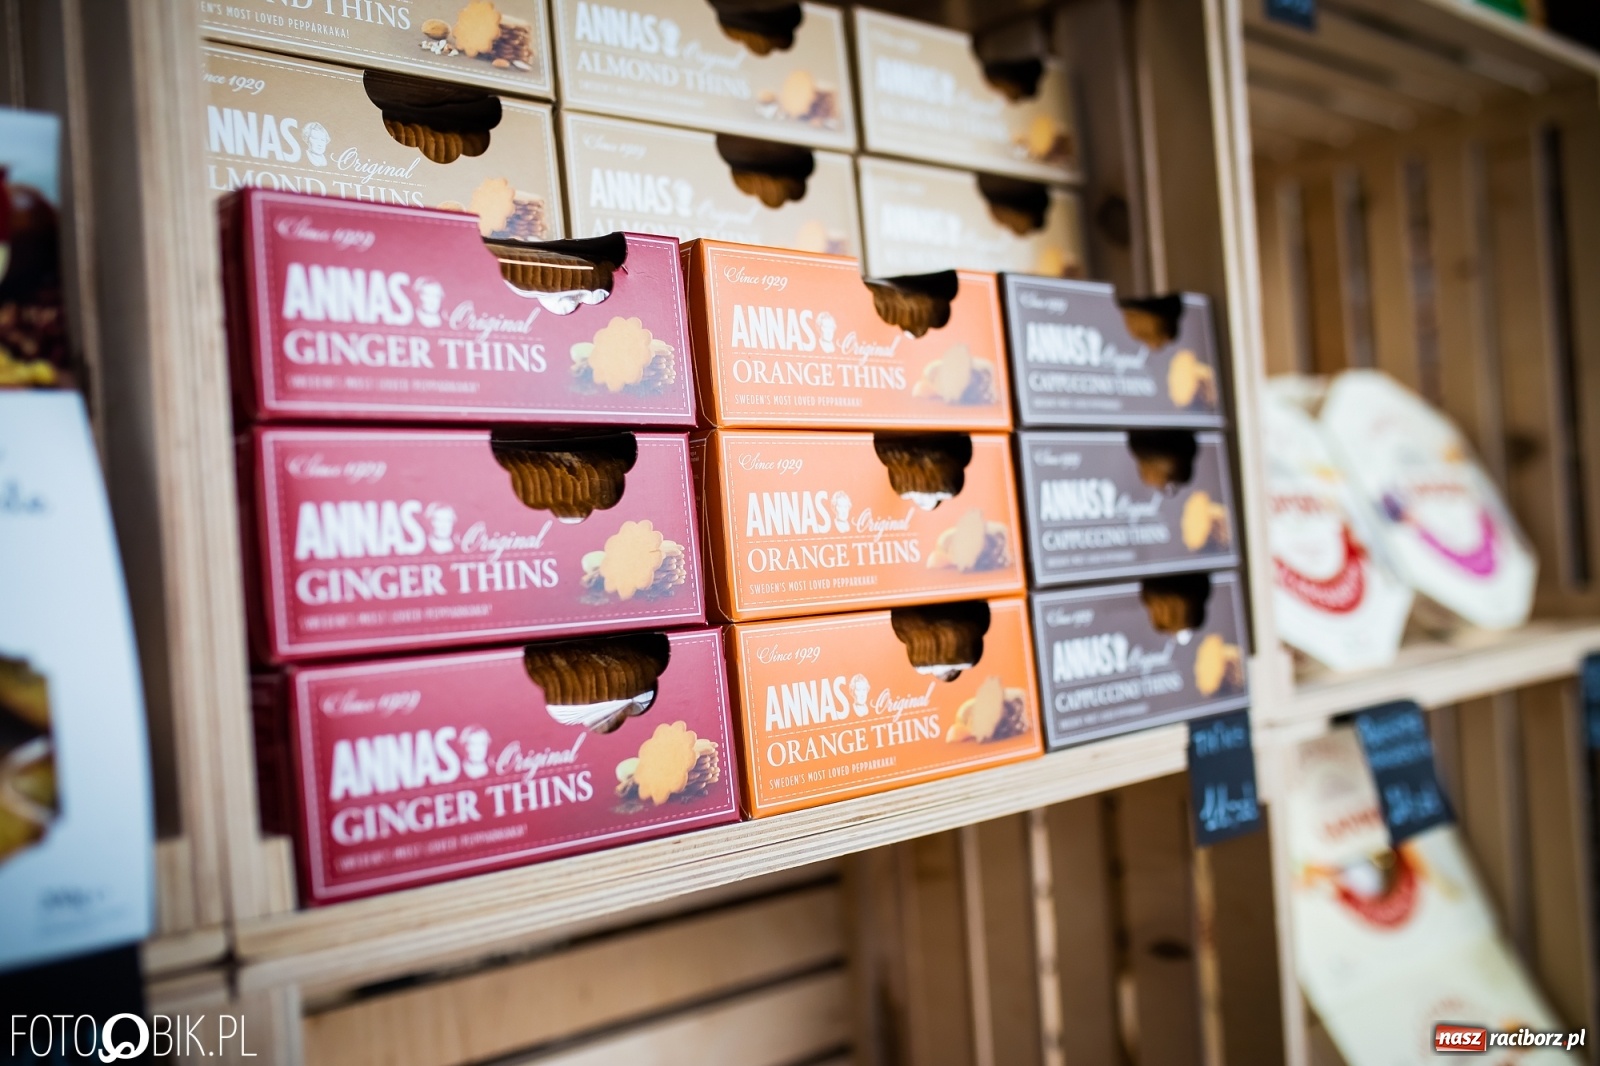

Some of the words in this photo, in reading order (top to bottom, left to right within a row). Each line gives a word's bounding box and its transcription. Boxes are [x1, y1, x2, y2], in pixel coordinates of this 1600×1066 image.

[200, 2, 223, 15] EN'S
[226, 6, 251, 20] MOST
[255, 12, 284, 26] LOVED
[288, 18, 350, 38] PEPPARKAKA!
[574, 1, 658, 55] ANNAS
[229, 75, 265, 95] 1929
[576, 50, 679, 87] ALMOND
[684, 69, 751, 99] THINS
[207, 105, 302, 164] NNAS
[207, 165, 326, 197] LMOND
[332, 181, 424, 208] THINS
[330, 146, 421, 185] Original
[590, 167, 673, 216] ANNAS
[282, 263, 414, 328] ANNAS
[724, 264, 759, 284] Since
[761, 274, 788, 292] 1929
[442, 300, 541, 344] Original
[731, 304, 816, 352] ANNAS
[283, 329, 436, 369] GINGER
[439, 338, 548, 374] THINS
[836, 331, 900, 366] Original
[732, 359, 834, 387] ORANGE
[837, 363, 907, 390] THINS
[734, 394, 771, 406] SWEDEN'S
[773, 395, 791, 406] MOST
[793, 396, 815, 407] LOVED
[739, 452, 774, 471] Since
[776, 459, 803, 475] 1929
[295, 499, 426, 560] ANNAS
[746, 490, 832, 537] ANNAS
[851, 506, 915, 542] Original
[456, 520, 555, 563] Original
[747, 542, 849, 573] ORANGE
[851, 538, 921, 567] THINS
[296, 560, 447, 607] GINGER
[450, 558, 560, 595] THINS
[749, 582, 786, 595] SWEDEN'S
[788, 580, 807, 592] MOST
[809, 578, 831, 591] LOVED
[756, 644, 793, 664] Since
[794, 646, 821, 665] 1929
[765, 675, 850, 732] ANNAS
[869, 681, 936, 723] Original
[487, 731, 587, 781] Original
[766, 727, 868, 767] ORANGE
[870, 714, 941, 748] THINS
[330, 725, 461, 802] ANNAS
[769, 773, 805, 790] SWEDEN'S
[808, 769, 826, 782] MOST
[828, 765, 850, 780] LOVED
[331, 790, 481, 848] GINGER
[485, 770, 594, 818] THINS
